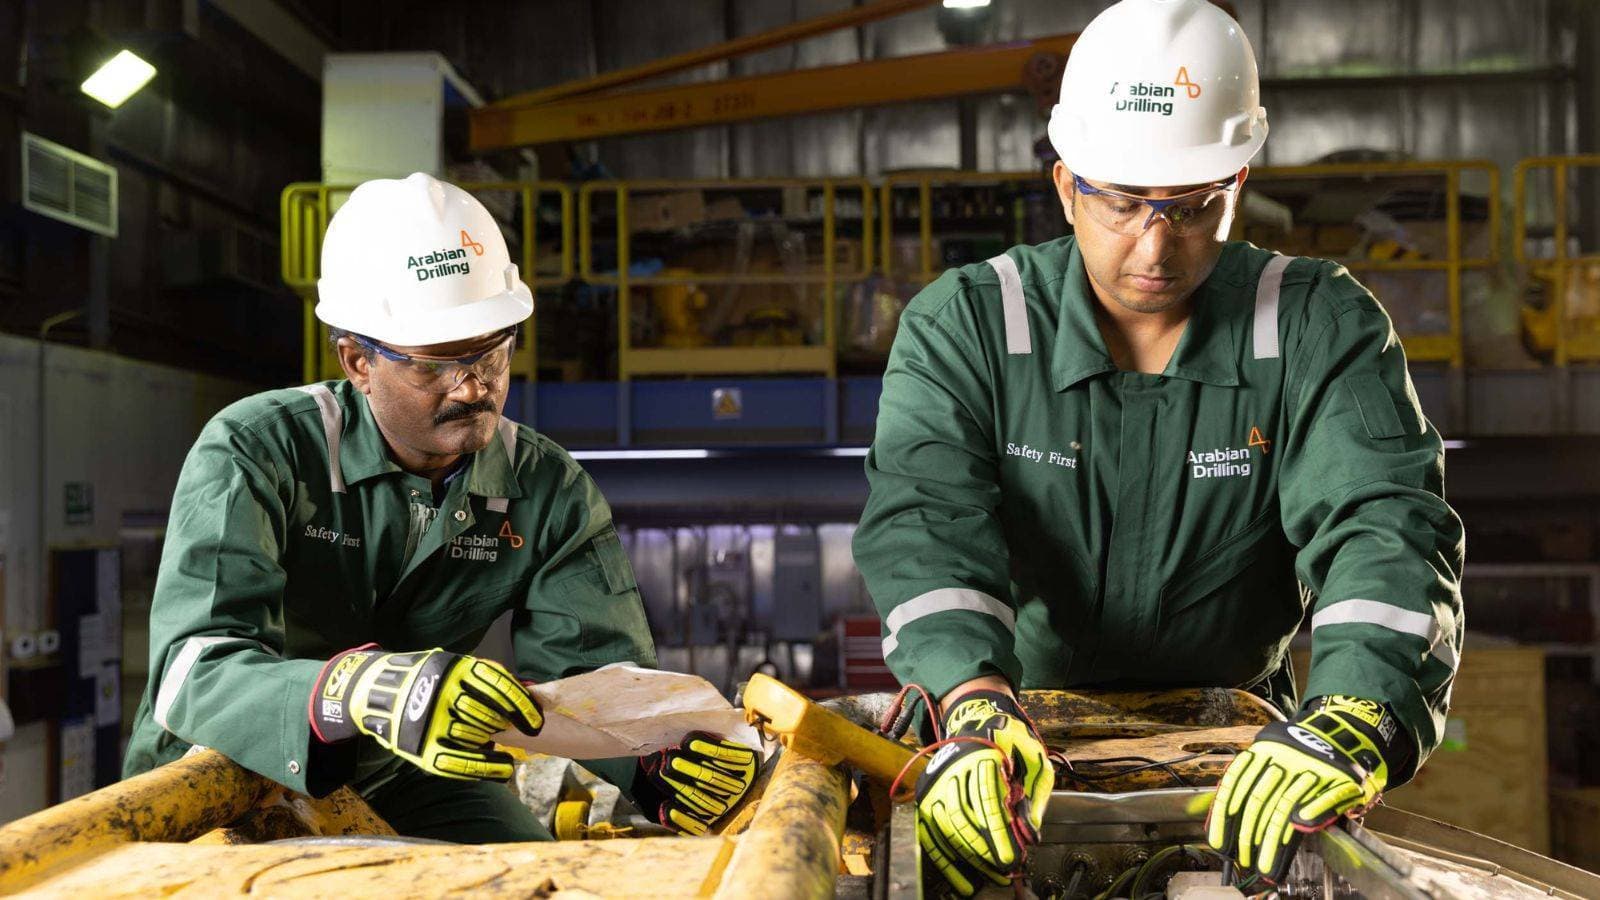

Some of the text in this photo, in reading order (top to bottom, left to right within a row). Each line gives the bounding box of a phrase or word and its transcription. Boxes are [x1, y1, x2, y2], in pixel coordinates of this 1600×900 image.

[1110, 82, 1174, 97] abian
[1116, 98, 1173, 116] Drilling
[407, 248, 467, 269] Arabian
[416, 262, 470, 281] Drilling
[1006, 442, 1077, 469] Safety First
[1186, 447, 1250, 464] Arabian
[1193, 462, 1251, 479] Drilling
[304, 524, 340, 543] Safety
[453, 534, 499, 547] rabian
[451, 546, 498, 562] Drilling
